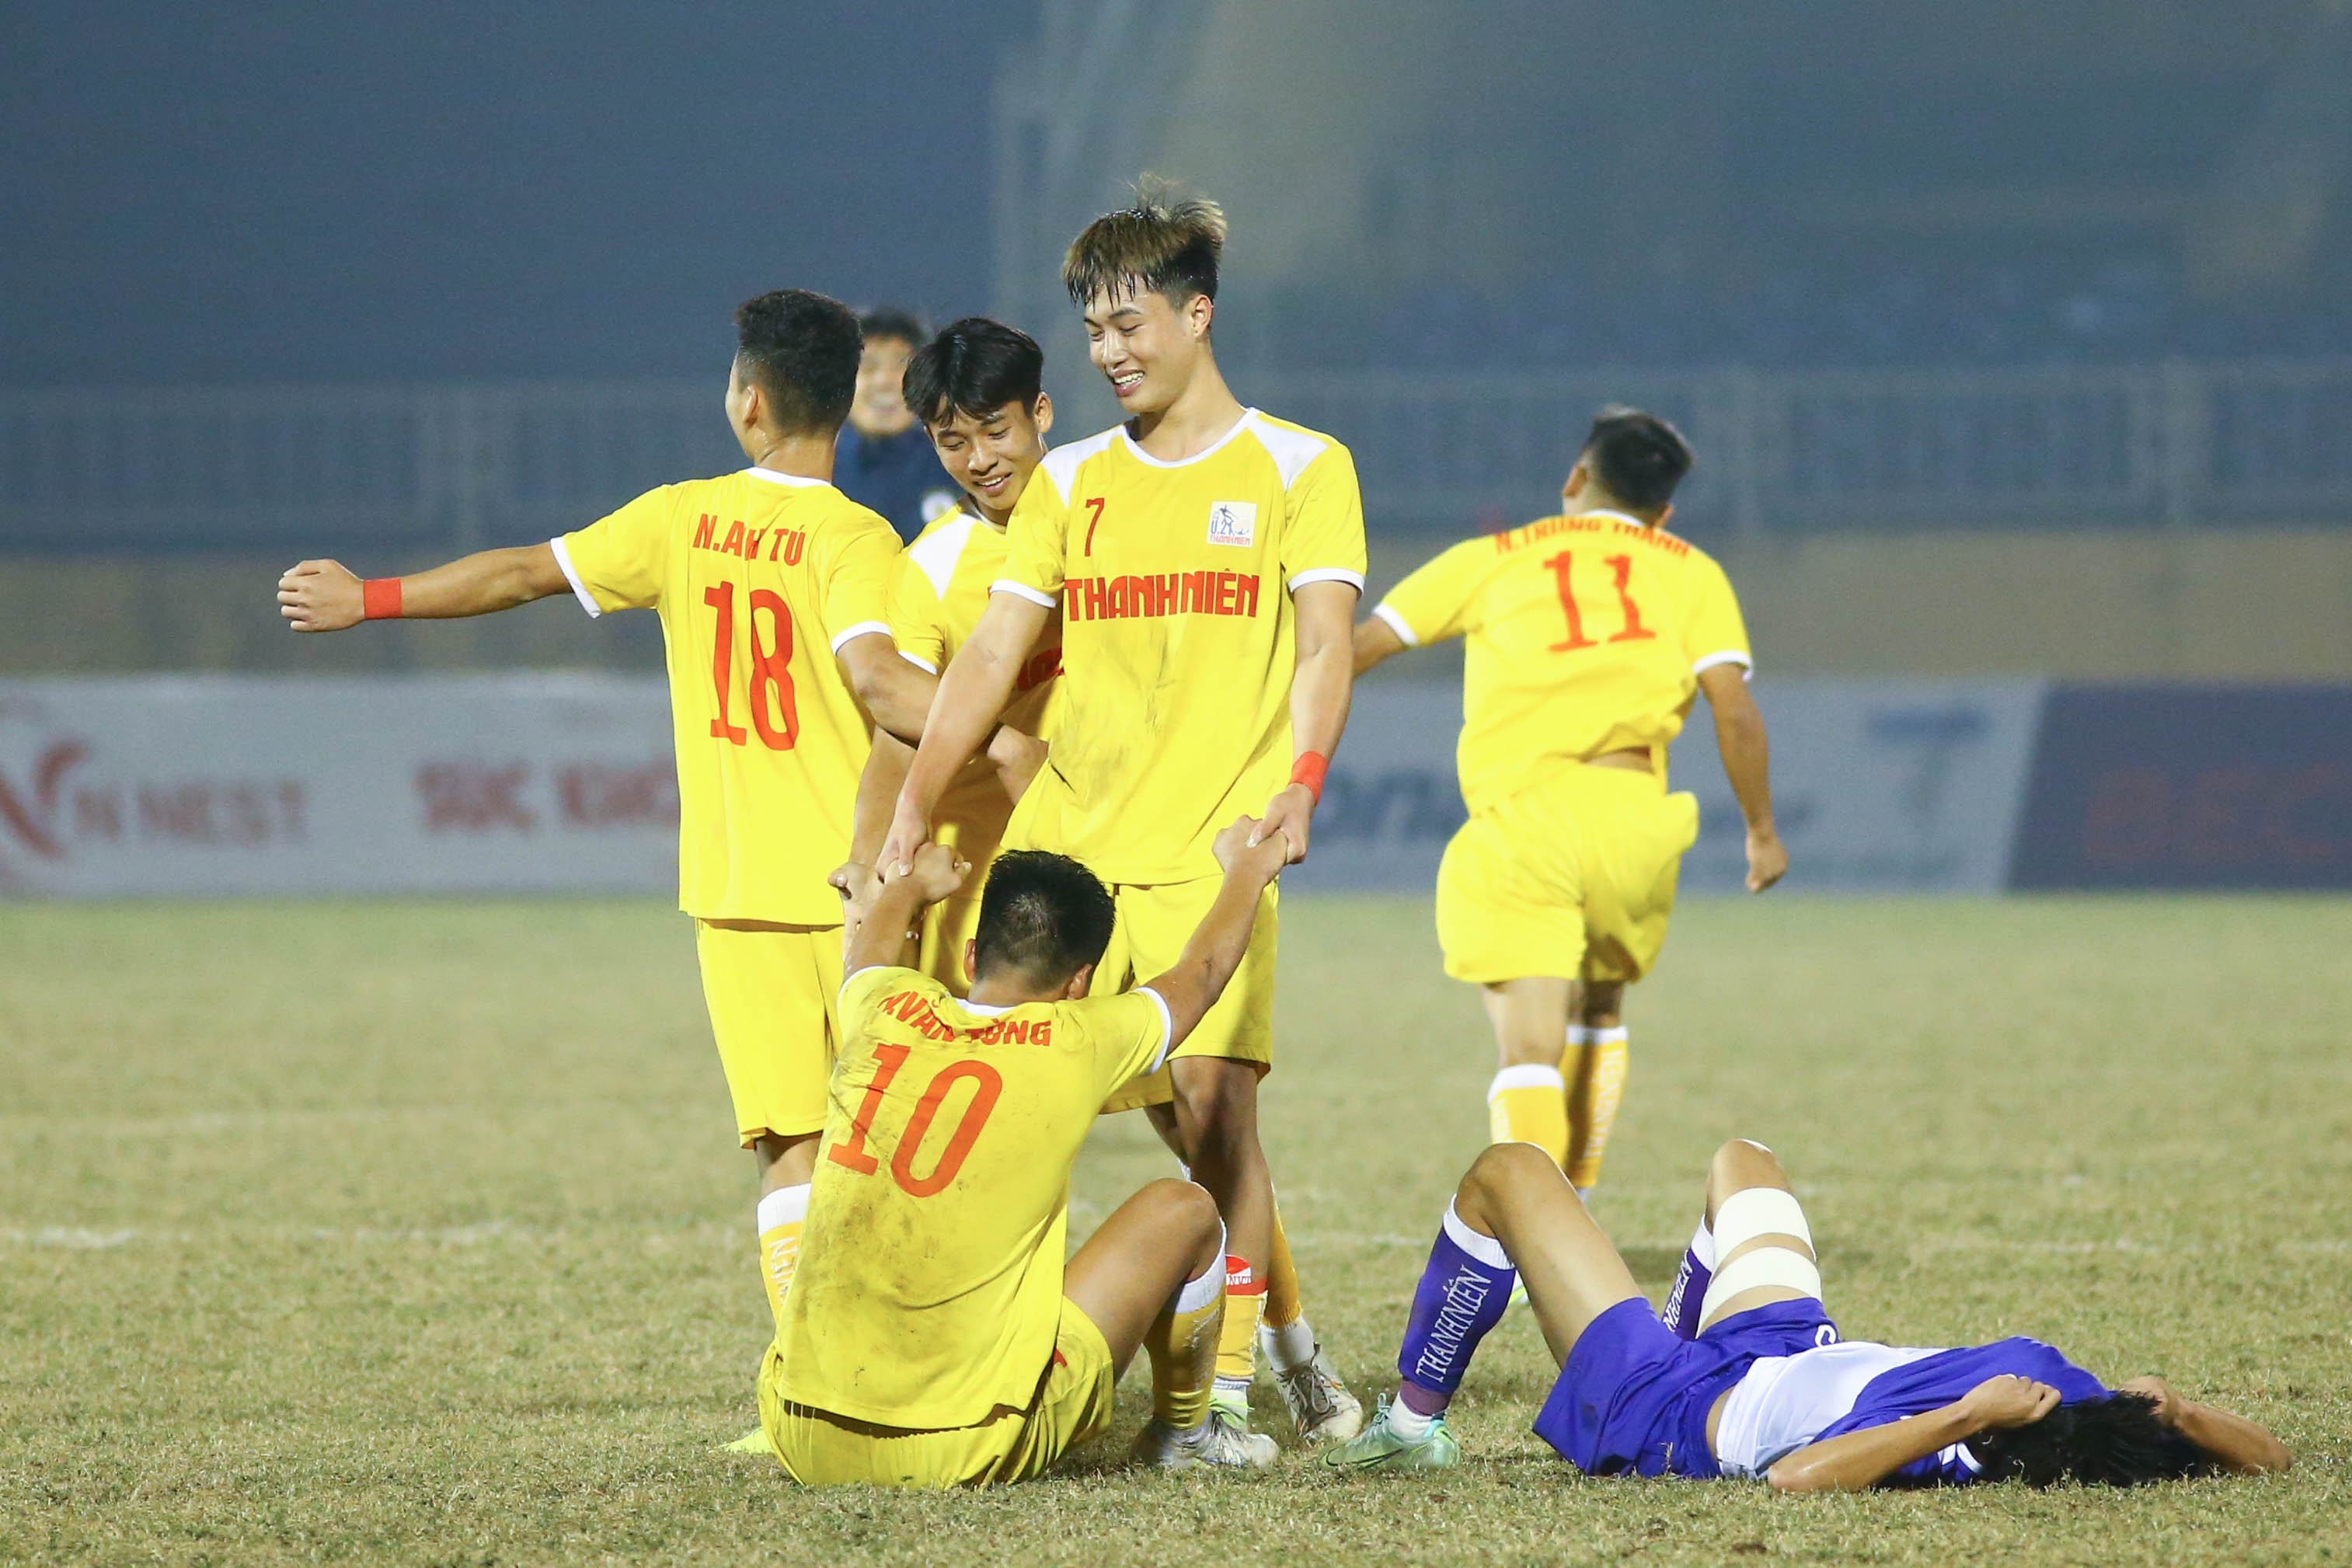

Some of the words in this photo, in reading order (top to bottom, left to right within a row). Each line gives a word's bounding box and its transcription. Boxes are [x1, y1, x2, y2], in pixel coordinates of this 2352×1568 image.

[769, 524, 806, 566] TÚ
[1085, 497, 1105, 557] 7
[1064, 567, 1260, 622] THANHNIÊN
[1542, 549, 1657, 652] 11
[703, 580, 800, 751] 18
[827, 1042, 1003, 1198] 10
